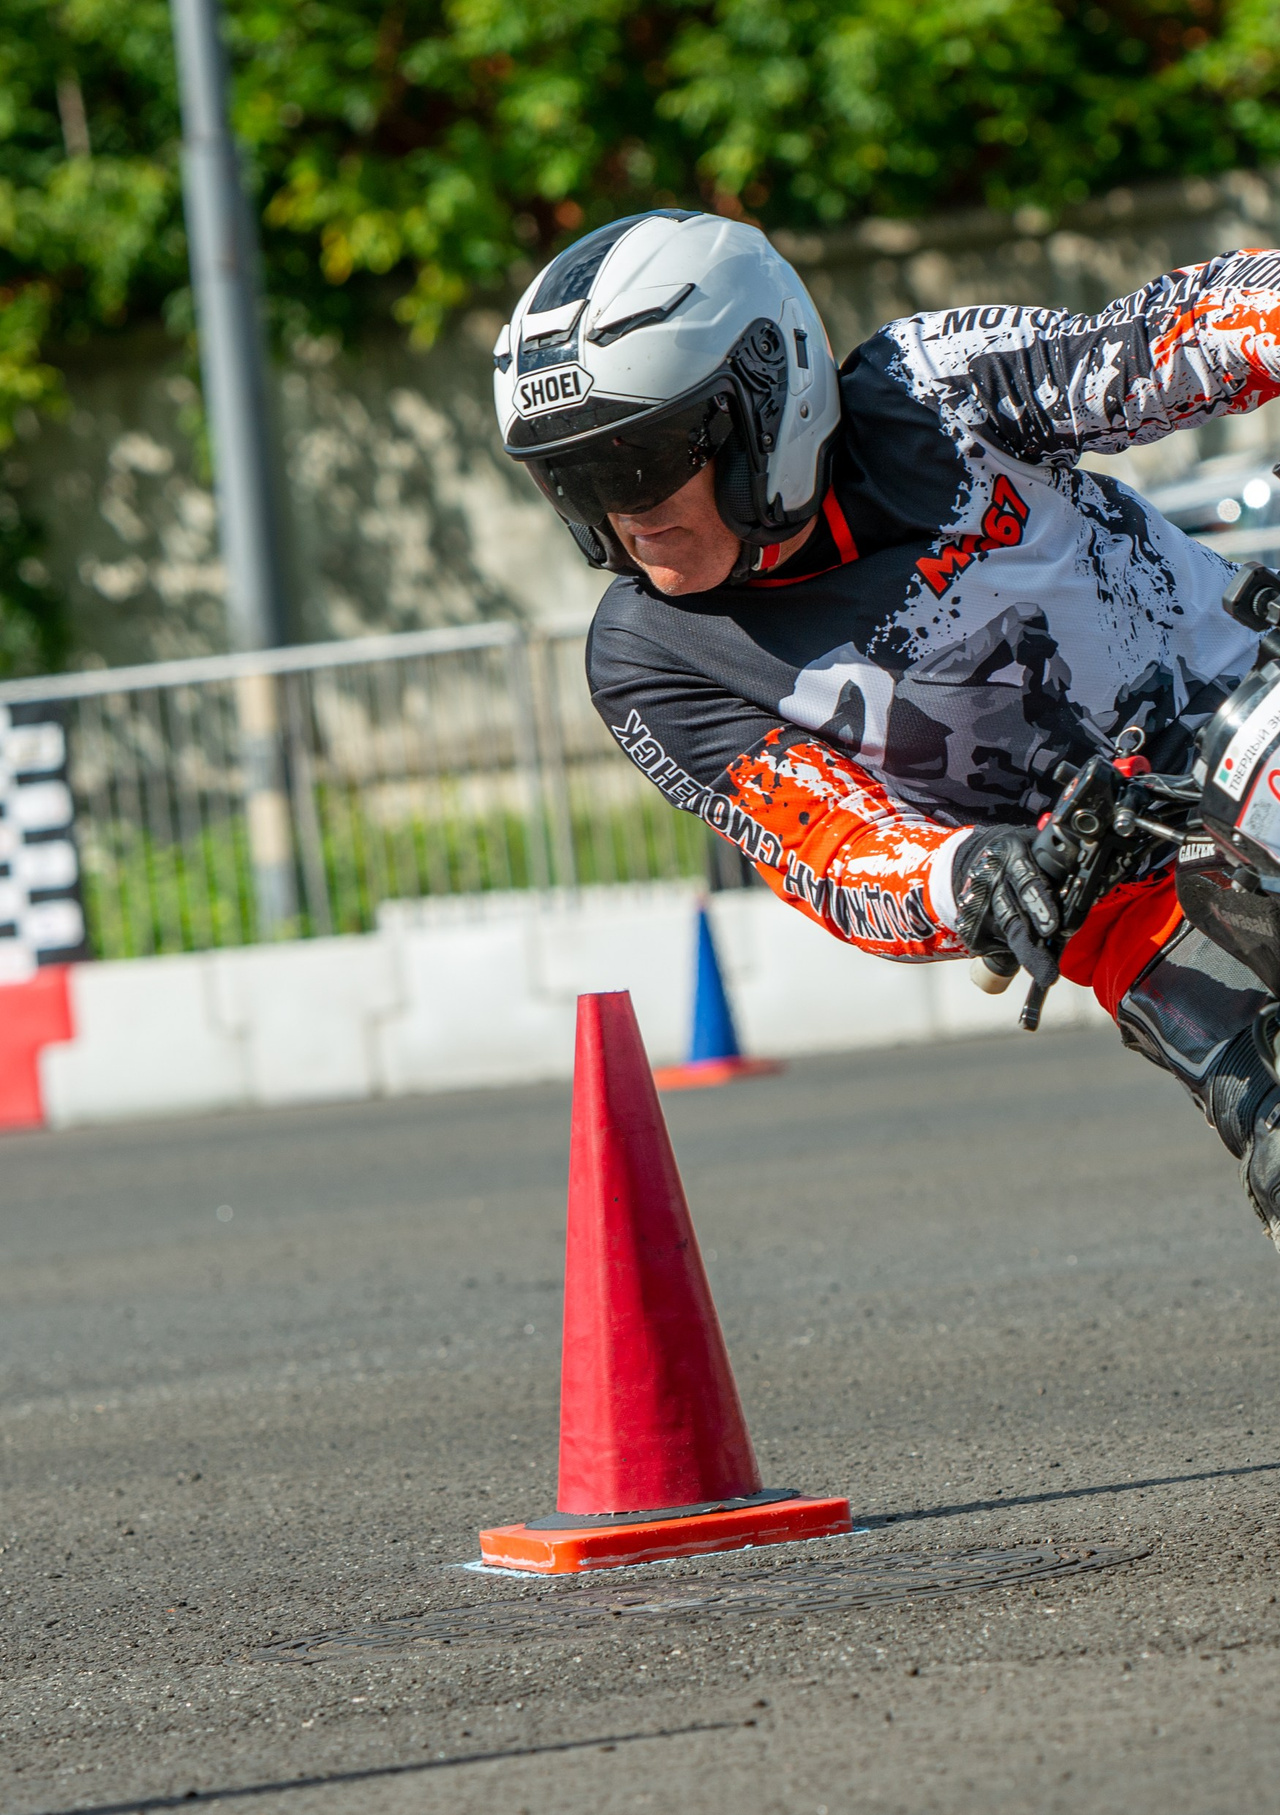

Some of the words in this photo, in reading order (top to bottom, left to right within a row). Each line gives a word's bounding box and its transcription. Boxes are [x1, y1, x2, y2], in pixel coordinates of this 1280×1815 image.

[519, 370, 581, 410] SHOEI
[915, 473, 1031, 599] M67
[1229, 727, 1274, 793] ТВЕРДЫЙ
